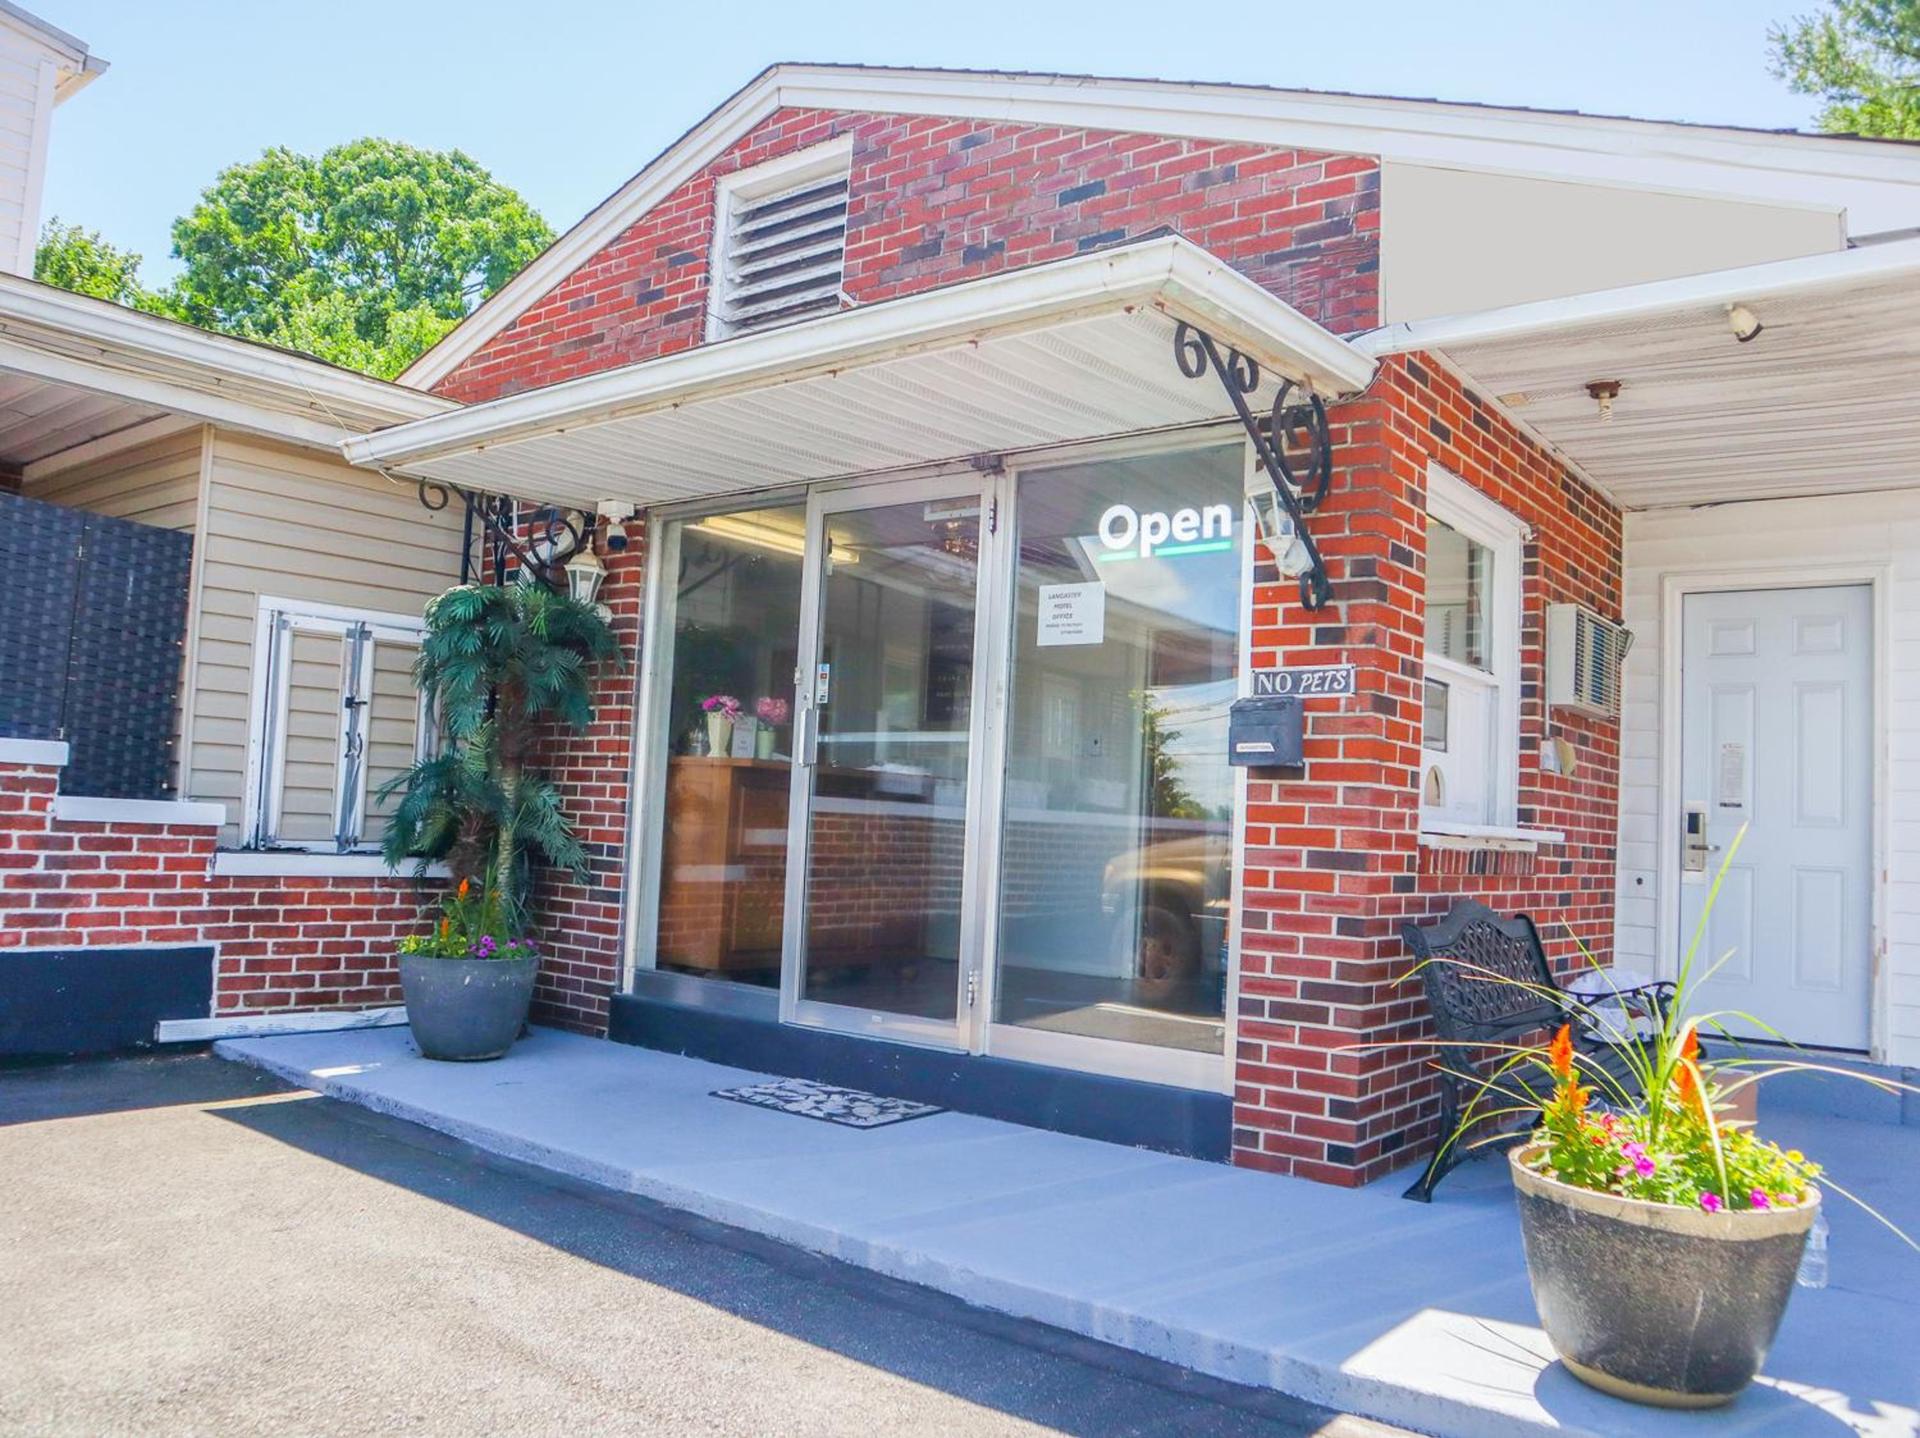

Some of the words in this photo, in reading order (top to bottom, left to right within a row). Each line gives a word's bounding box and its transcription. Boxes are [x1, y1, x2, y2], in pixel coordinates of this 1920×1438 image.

[1099, 504, 1232, 558] Open
[1258, 672, 1292, 694] NO
[1298, 670, 1347, 693] PETS
